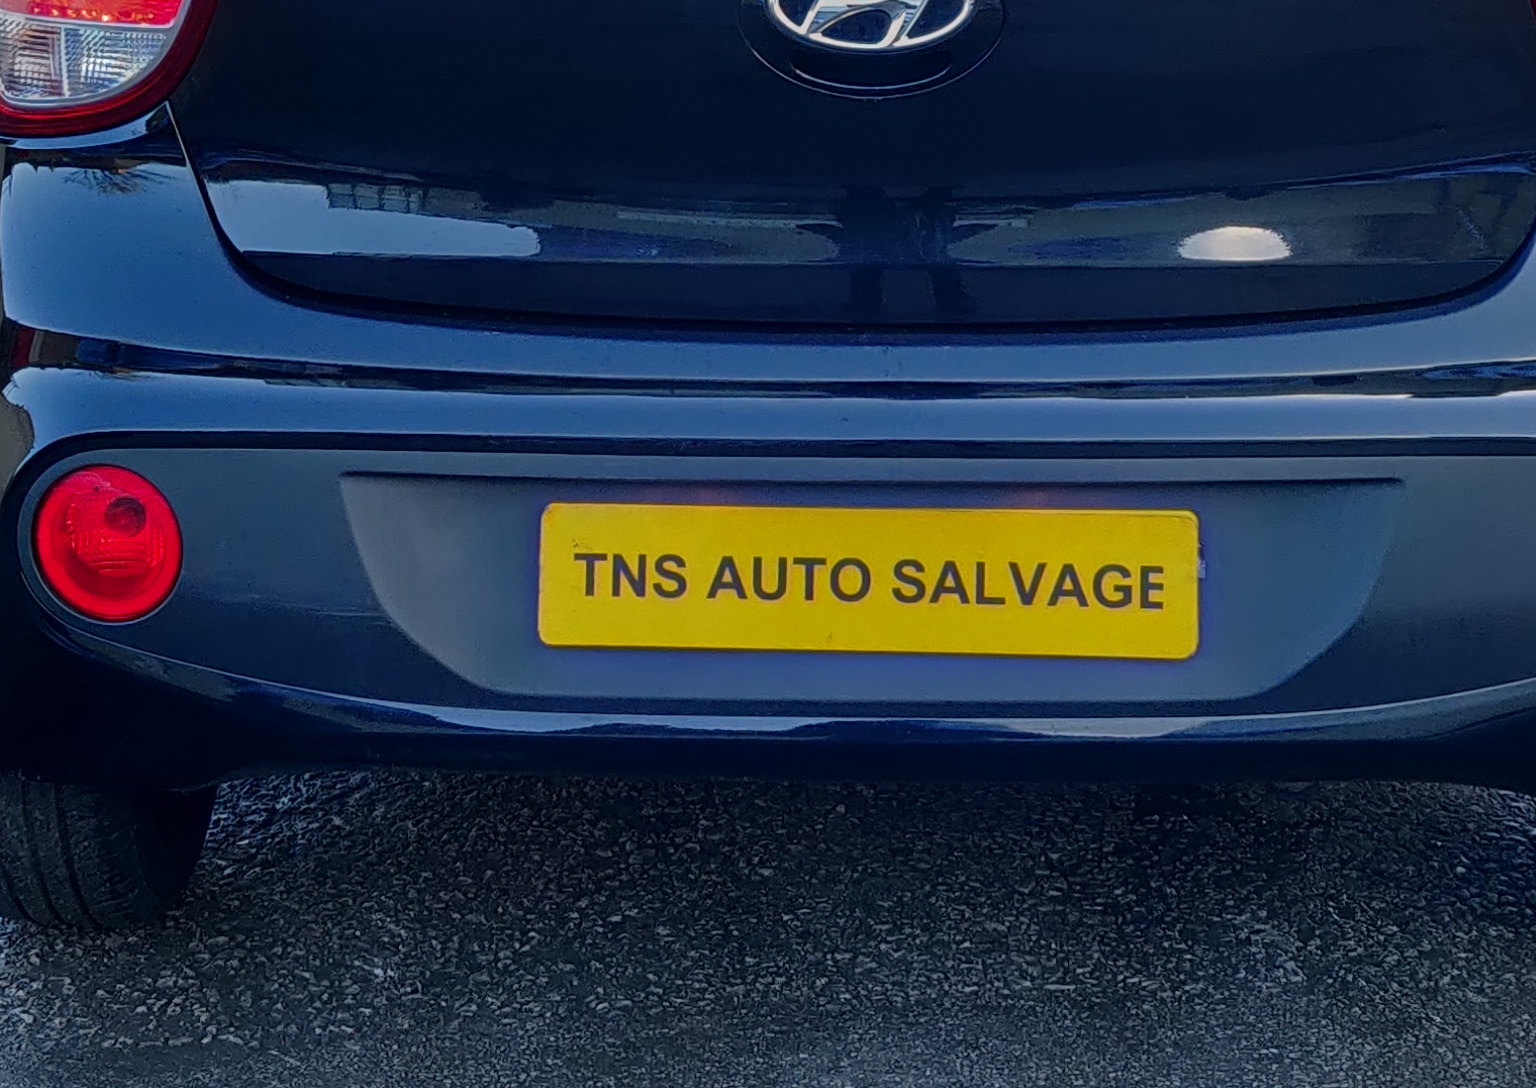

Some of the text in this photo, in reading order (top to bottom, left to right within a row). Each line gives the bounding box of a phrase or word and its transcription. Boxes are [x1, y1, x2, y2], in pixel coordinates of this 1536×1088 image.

[573, 552, 1165, 610] TNS AUTO SALVAGE
